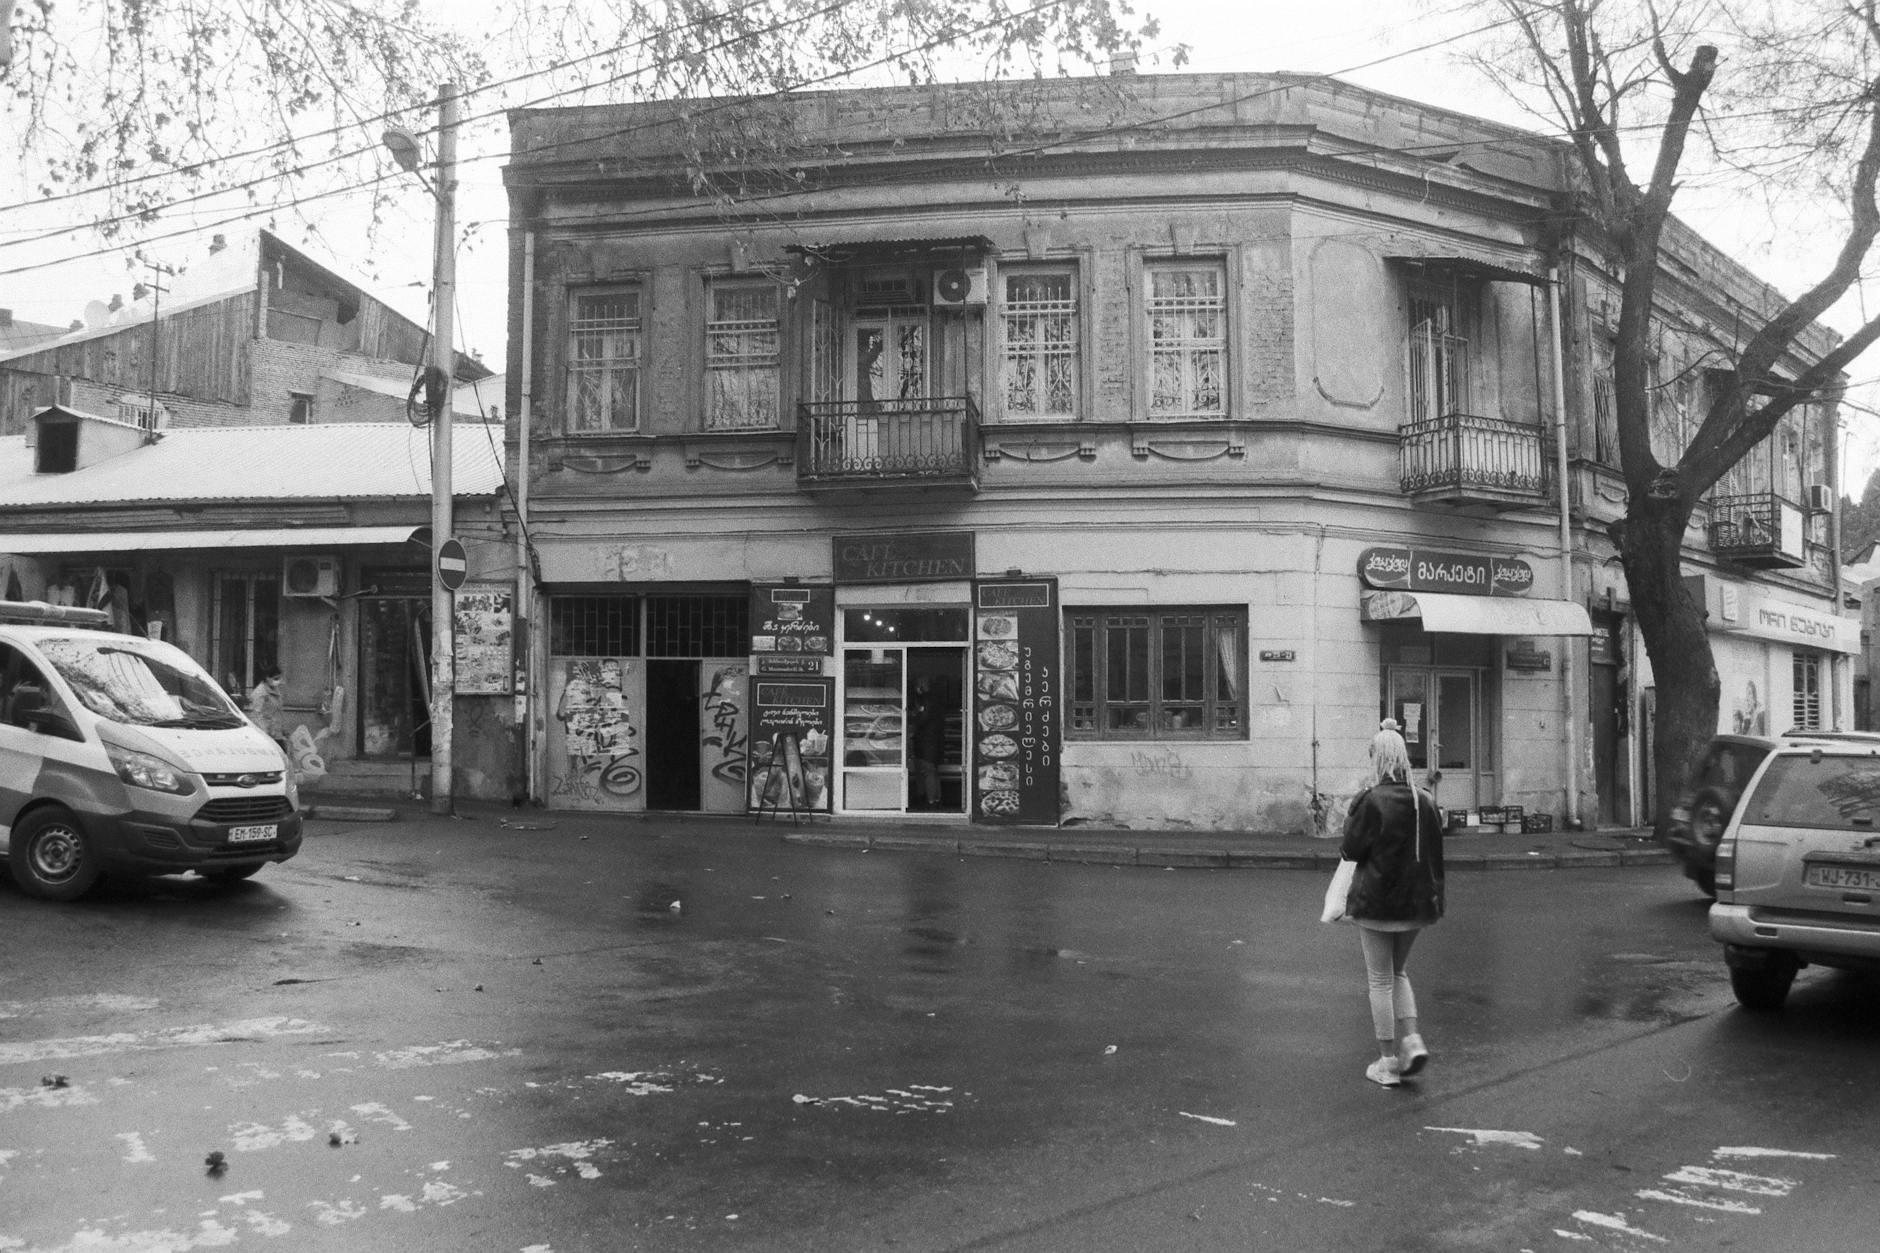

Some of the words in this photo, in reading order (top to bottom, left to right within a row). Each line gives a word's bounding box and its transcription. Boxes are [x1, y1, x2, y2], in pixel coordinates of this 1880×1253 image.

[867, 558, 965, 577] KITCHEN
[1417, 561, 1485, 584] მარკეტი
[808, 661, 819, 671] 21
[773, 696, 823, 706] KITCHEN
[1021, 646, 1036, 786] უგემრიელესი
[1039, 666, 1052, 766] კერძები
